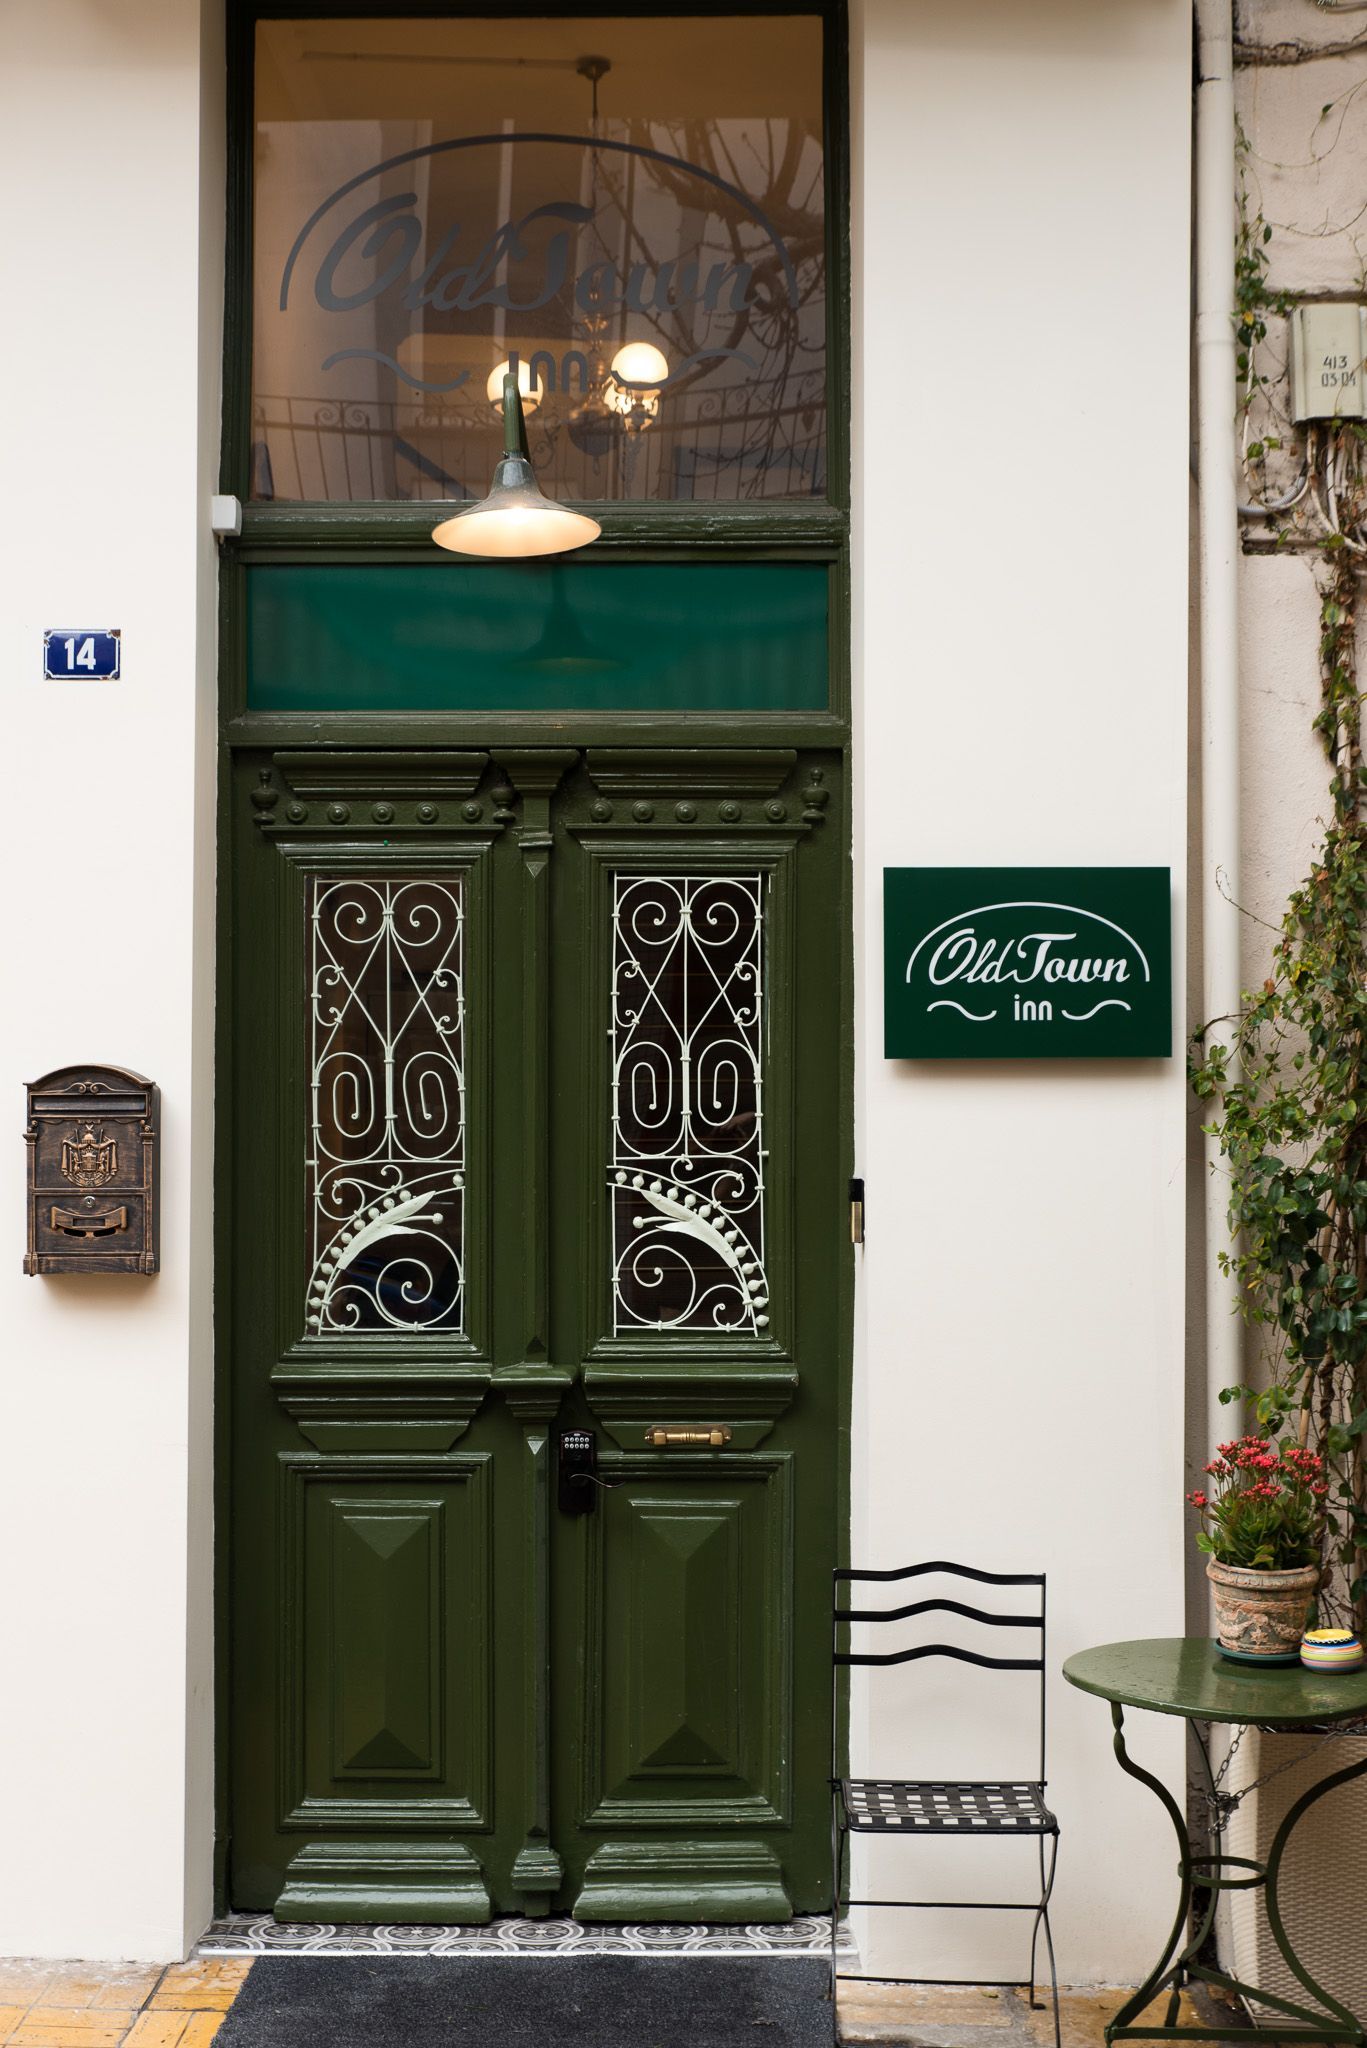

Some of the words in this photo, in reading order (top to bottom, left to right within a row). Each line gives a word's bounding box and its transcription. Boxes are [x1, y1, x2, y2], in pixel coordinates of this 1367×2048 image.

[314, 192, 512, 312] Old
[510, 201, 765, 312] Town
[1323, 356, 1347, 369] 413
[64, 637, 97, 670] 14
[928, 928, 1016, 985] Old
[1008, 932, 1130, 983] Town
[1014, 993, 1053, 1021] inn
